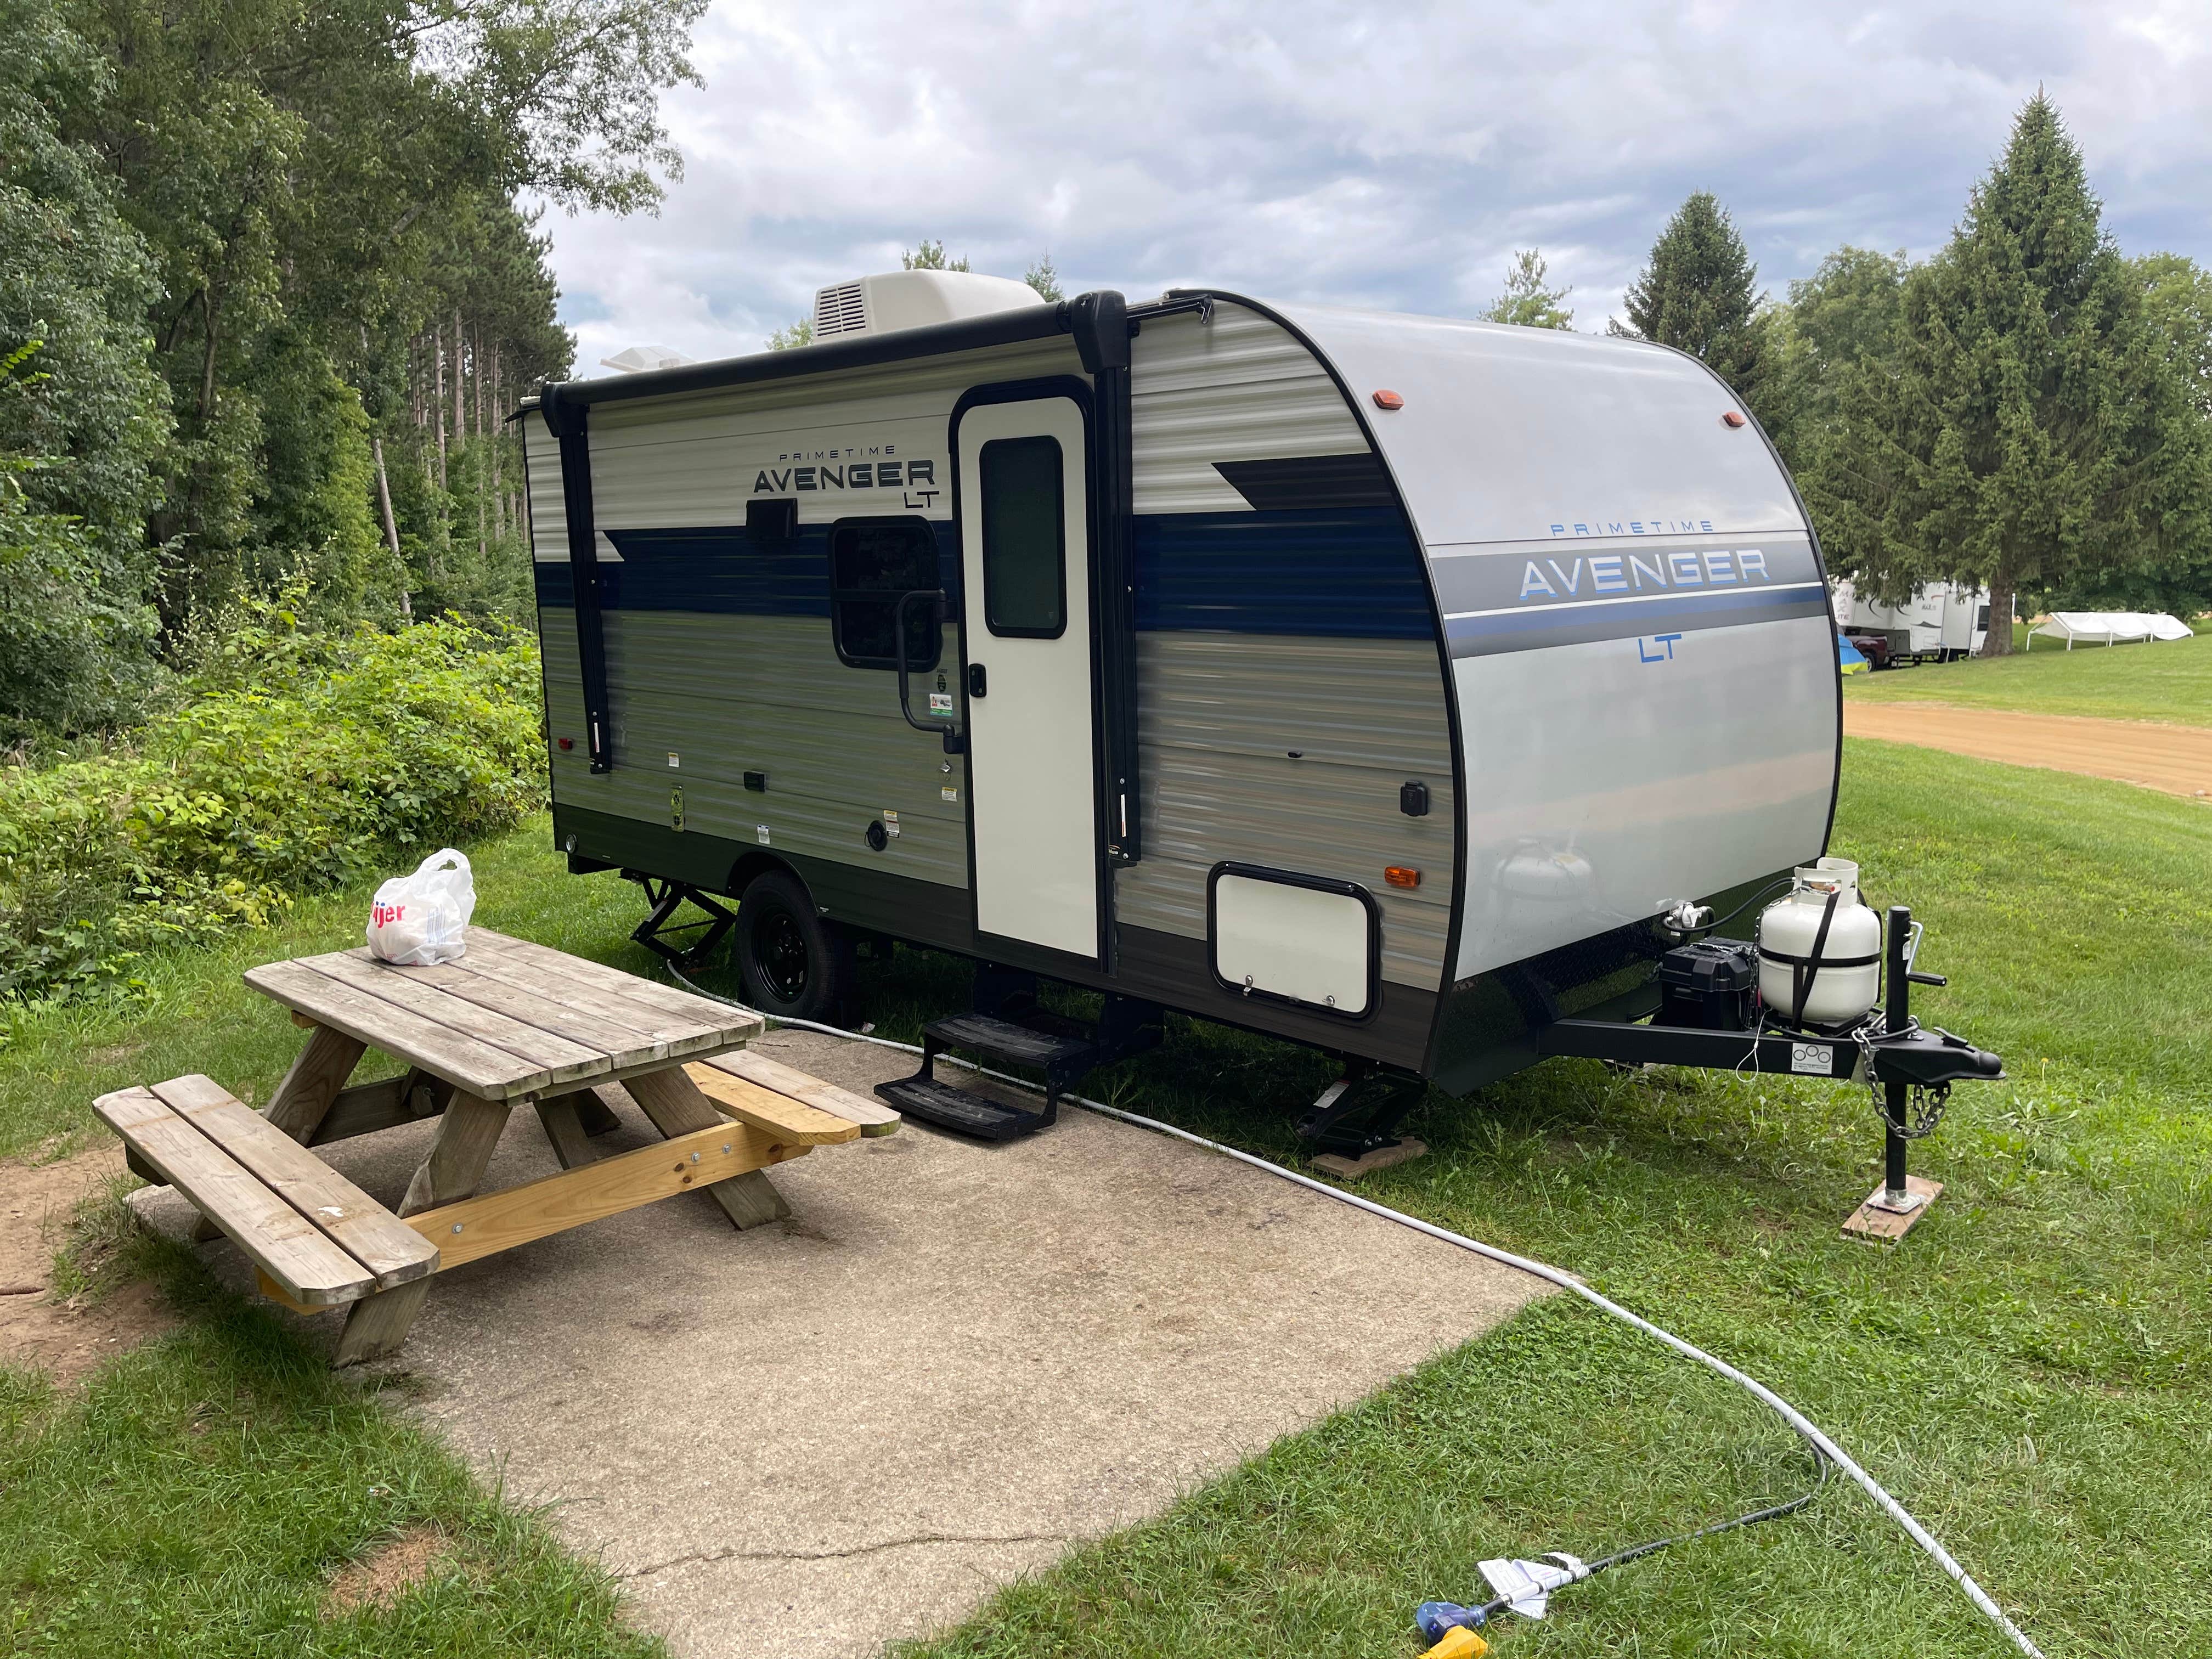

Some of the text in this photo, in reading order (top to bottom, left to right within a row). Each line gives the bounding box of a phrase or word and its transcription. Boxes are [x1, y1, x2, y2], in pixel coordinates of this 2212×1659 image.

[779, 445, 895, 462] PRIMETIME
[753, 460, 935, 493] AVENGER
[904, 490, 940, 509] LT
[1550, 520, 1714, 537] PRIMETIME
[1519, 549, 1771, 600] AVENGER
[1638, 633, 1682, 663] LT
